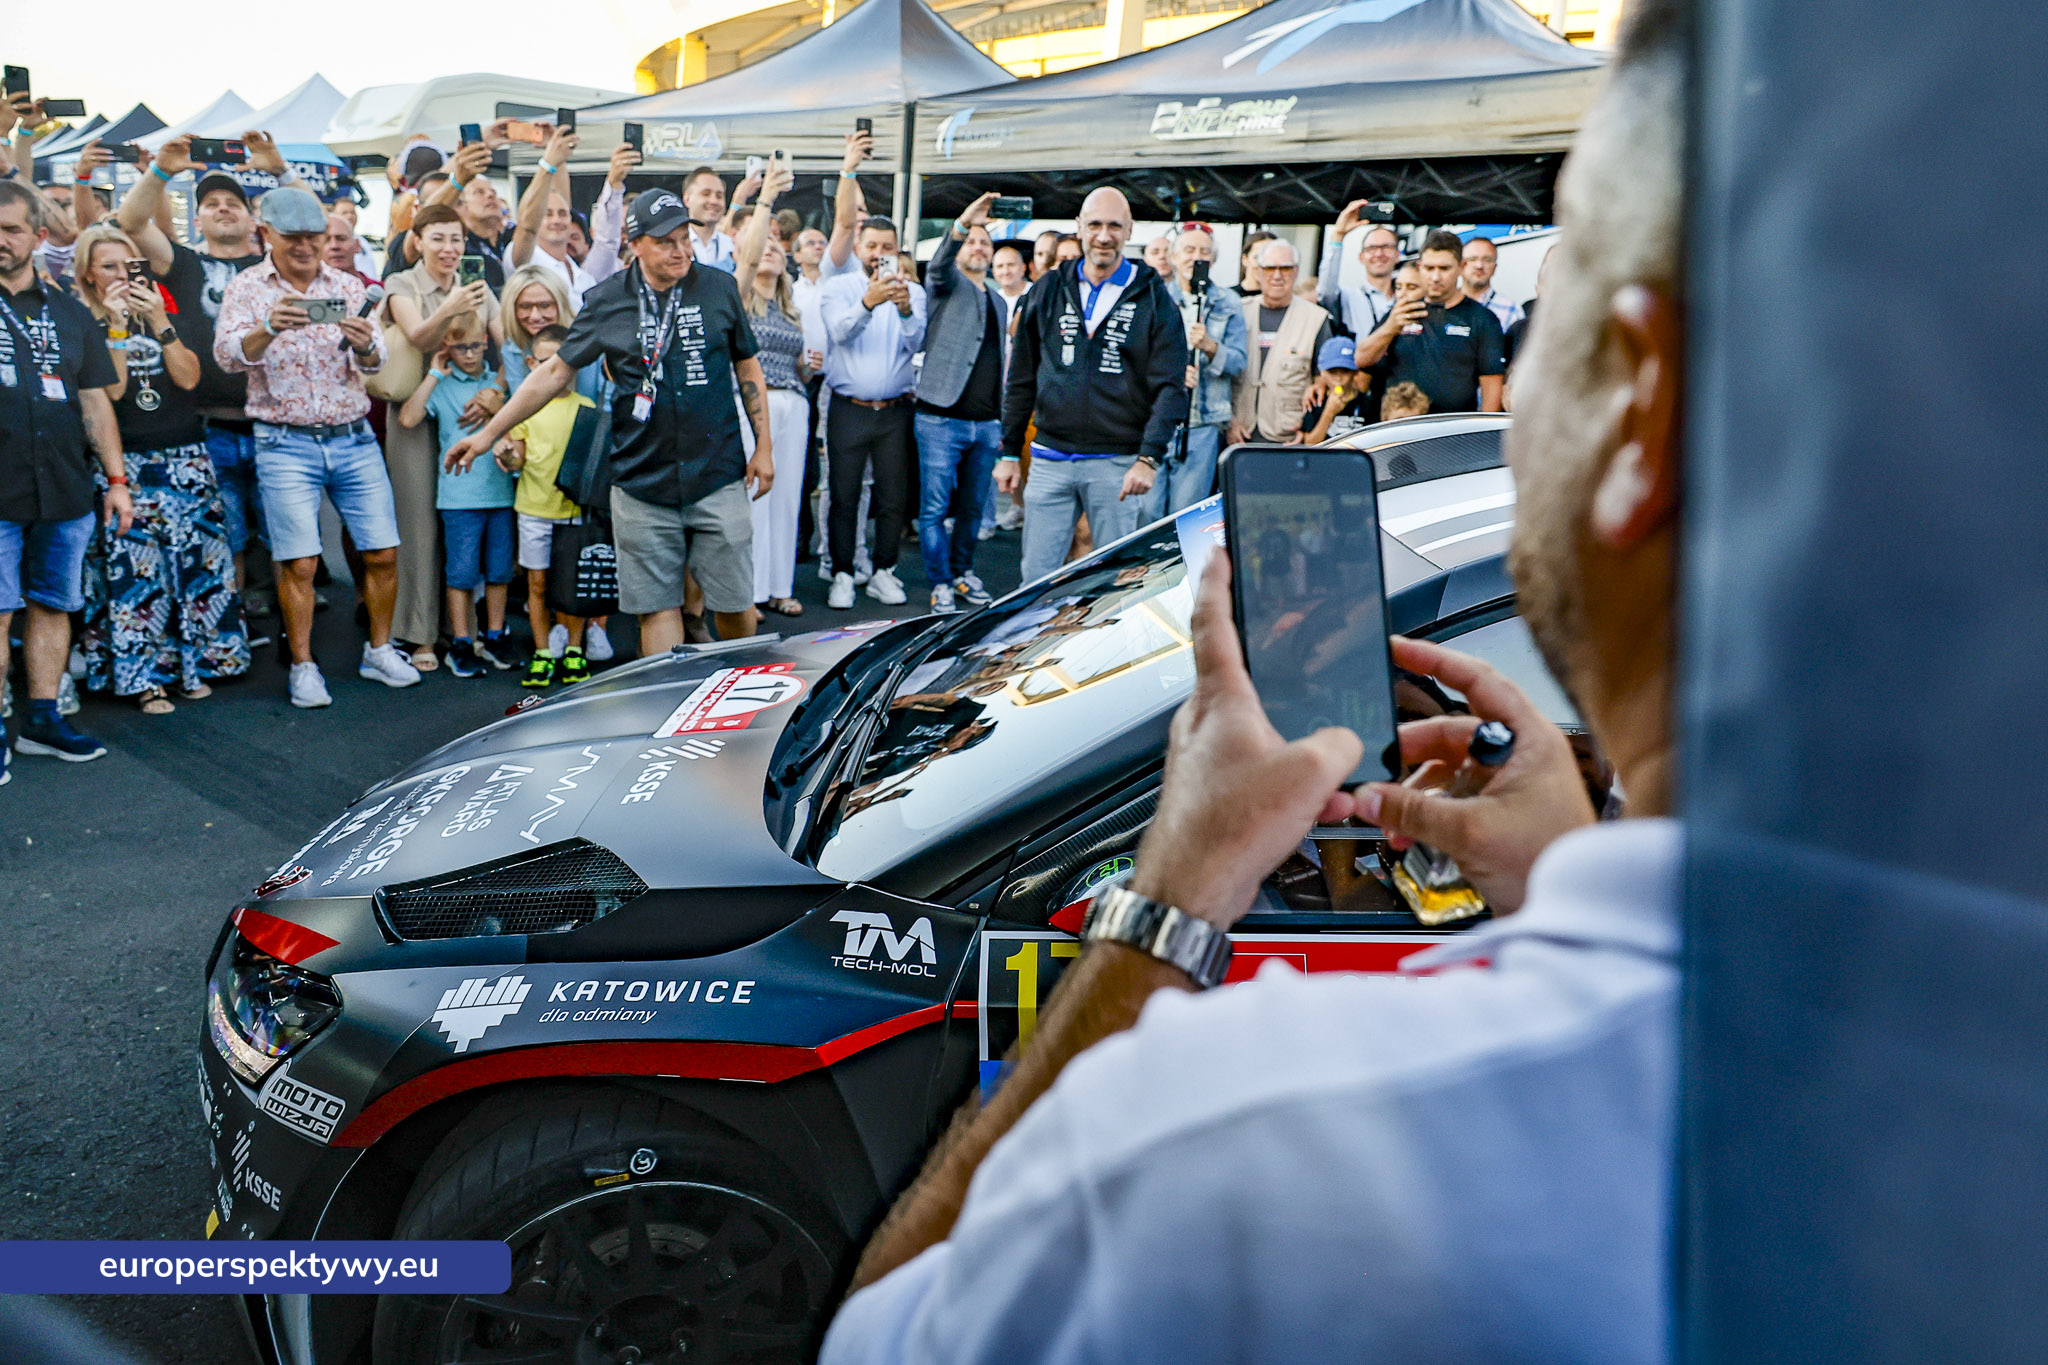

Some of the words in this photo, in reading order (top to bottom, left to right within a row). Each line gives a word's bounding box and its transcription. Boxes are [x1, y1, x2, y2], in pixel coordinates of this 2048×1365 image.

[680, 692, 722, 732] POLAND
[725, 681, 790, 703] 17
[620, 760, 678, 805] KSSE
[440, 784, 498, 838] WARD
[467, 781, 523, 832] ATLAS
[829, 909, 937, 965] TM
[830, 955, 937, 978] TECH-MOL
[547, 980, 756, 1004] KATOWICE
[538, 1008, 569, 1023] dla
[572, 1007, 658, 1025] odmiany
[265, 1099, 332, 1137] WIZJA
[271, 1077, 344, 1121] MOTO
[245, 1167, 282, 1211] KSSE
